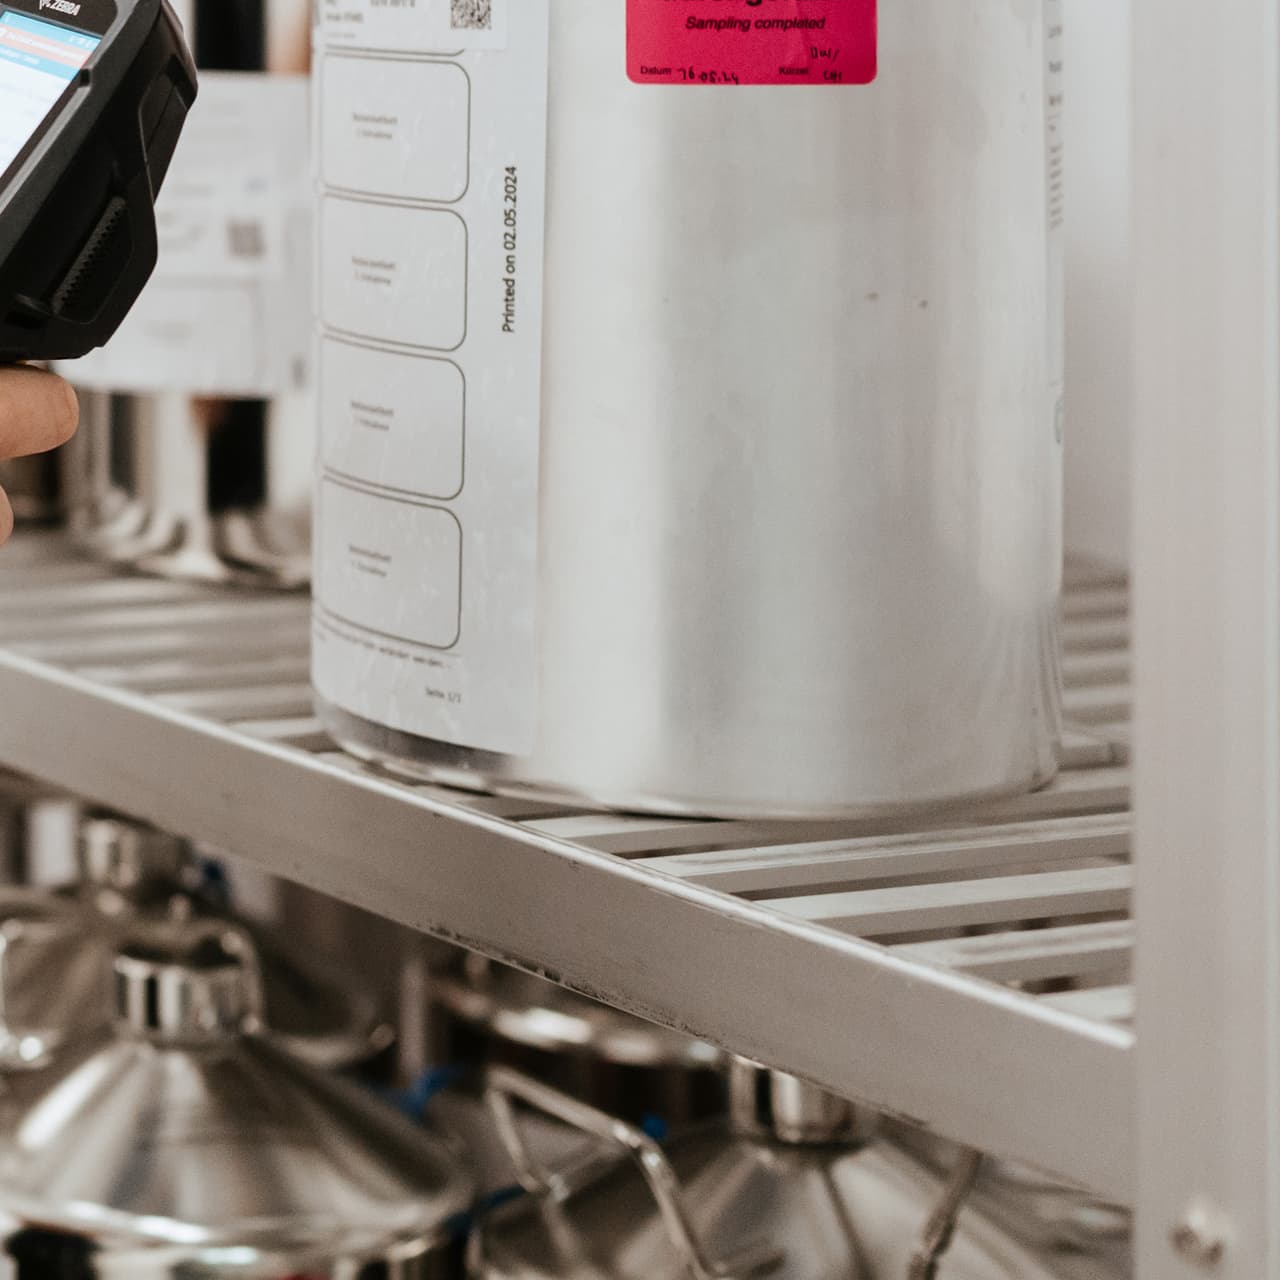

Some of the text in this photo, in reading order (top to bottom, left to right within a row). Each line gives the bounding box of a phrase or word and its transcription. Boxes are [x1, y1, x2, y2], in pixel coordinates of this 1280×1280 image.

[685, 16, 826, 32] Sampling completed
[640, 65, 672, 76] Datum
[502, 166, 518, 333] Printed on 02.05.2024
